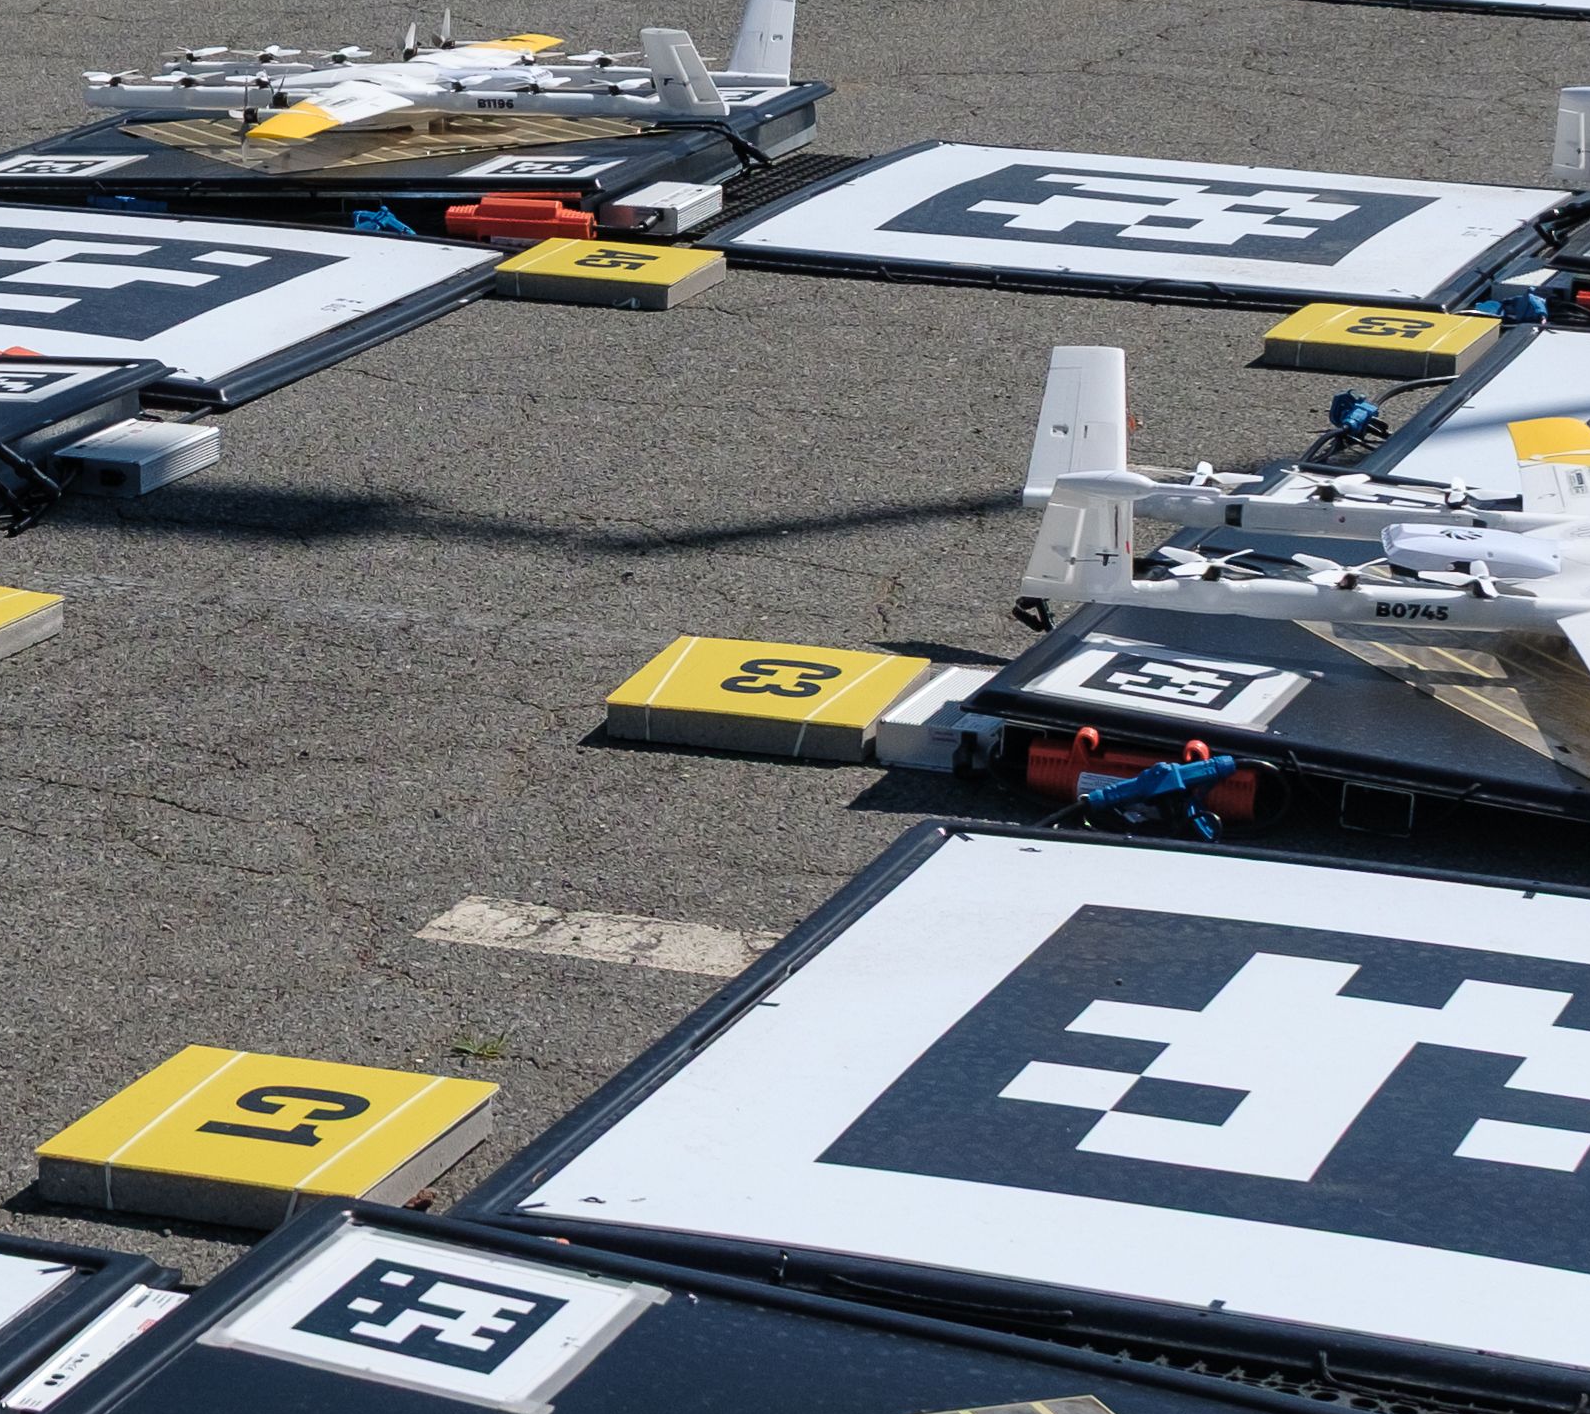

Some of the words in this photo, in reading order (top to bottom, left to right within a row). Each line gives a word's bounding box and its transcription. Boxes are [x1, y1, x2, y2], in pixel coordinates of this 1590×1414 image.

[477, 99, 514, 109] B1196
[574, 249, 661, 270] A5
[1346, 317, 1434, 338] C5
[1375, 602, 1449, 620] B0745
[720, 658, 843, 697] C3
[195, 1086, 371, 1147] C1
